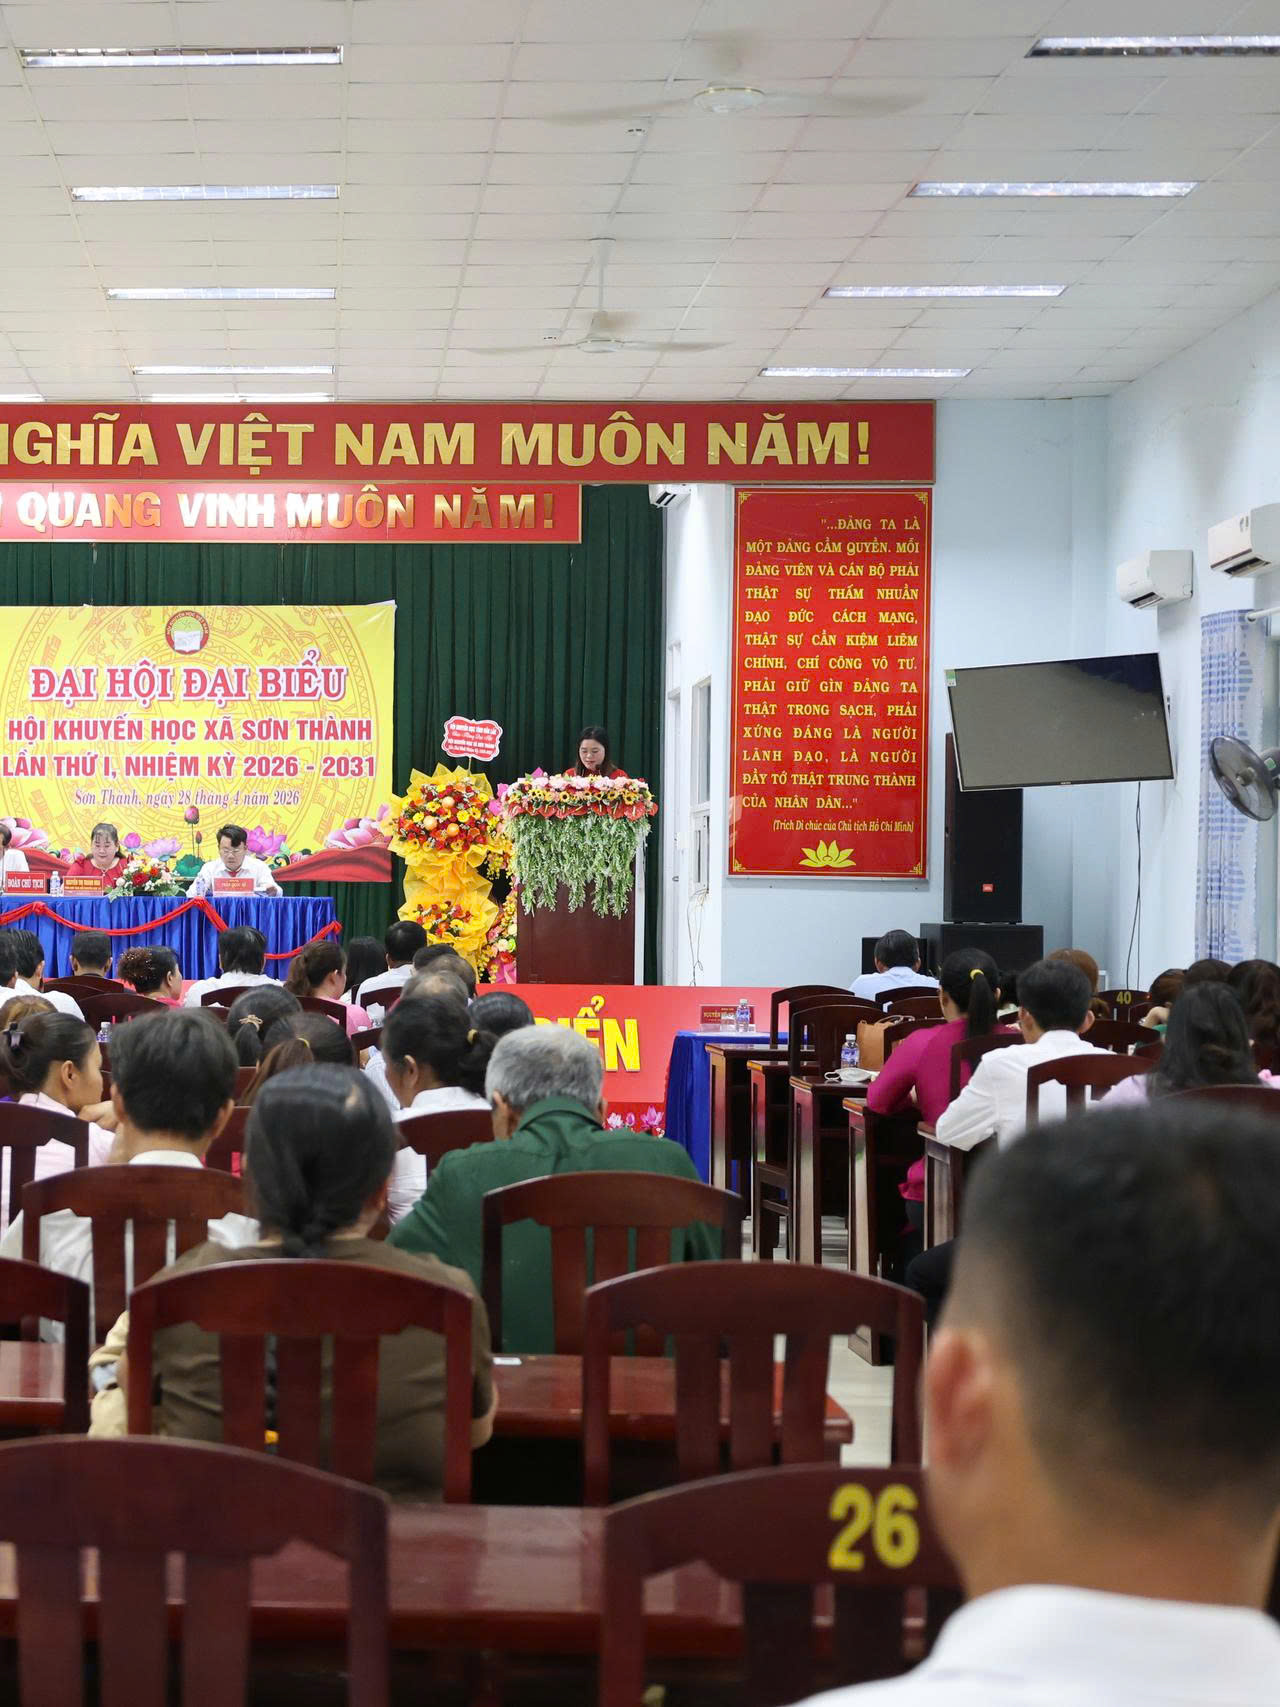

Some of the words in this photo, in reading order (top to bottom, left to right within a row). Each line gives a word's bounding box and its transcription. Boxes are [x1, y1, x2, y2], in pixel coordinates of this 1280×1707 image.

[175, 413, 314, 475] VIỆT
[335, 422, 475, 466] NAM
[501, 410, 686, 466] MUÔN
[706, 413, 870, 466] NĂM!
[17, 491, 161, 533] QUANG
[178, 492, 275, 529] VINH
[286, 484, 415, 529] MUÔN
[434, 487, 554, 529] NĂM!
[881, 520, 896, 529] TA
[905, 517, 920, 529] LÀ
[746, 539, 772, 556] MỘT
[777, 538, 810, 552] ĐẢNG
[815, 537, 841, 552] CẦM
[746, 562, 779, 576] ĐẢNG
[785, 563, 813, 576] VIÊN
[819, 563, 834, 576] VÀ
[840, 562, 864, 576] CÁN
[869, 563, 885, 579] BỘ
[890, 562, 919, 576] PHẢI
[746, 586, 778, 602] THẬT
[796, 588, 811, 603] SỰ
[829, 584, 864, 599] THẤM
[877, 584, 918, 599] NHUẦN
[745, 612, 770, 625] ĐẠO
[789, 609, 814, 622] ĐỨC
[833, 609, 866, 622] CÁCH
[745, 632, 777, 648] THẬT
[787, 633, 803, 649] SỰ
[812, 630, 836, 646] CẦN
[846, 633, 877, 649] KIỆM
[888, 633, 918, 646] LIÊM
[745, 656, 787, 670] CHÍNH,
[797, 655, 819, 669] CHÍ
[829, 656, 862, 669] CÔNG
[872, 656, 888, 669] VÔ
[898, 657, 917, 669] TƯ.
[31, 668, 96, 705] ĐẠI
[107, 659, 171, 705] HỘI
[183, 669, 246, 705] ĐẠI
[259, 649, 345, 697] BIỂU
[744, 678, 775, 693] PHẢI
[787, 678, 810, 693] GIỮ
[820, 678, 843, 693] GÌN
[853, 678, 890, 693] ĐẢNG
[900, 682, 917, 693] TA
[744, 702, 777, 718] THẬT
[787, 704, 829, 716] TRONG
[840, 705, 876, 718] SẠCH,
[888, 701, 917, 716] PHẢI
[8, 716, 45, 745] HỘI
[54, 714, 143, 740] KHUYẾN
[151, 720, 196, 745] HỌC
[204, 717, 233, 740] XÃ
[242, 718, 289, 740] SƠN
[297, 716, 371, 740] THÀNH
[743, 724, 782, 739] XỨNG
[793, 724, 832, 739] ĐÁNG
[844, 725, 862, 739] LÀ
[872, 725, 917, 739] NGƯỜI
[3, 749, 45, 777] LẦN
[54, 752, 98, 777] THỨ
[104, 756, 117, 778] I,
[126, 752, 198, 781] NHIỆM
[208, 753, 235, 777] KỲ
[244, 757, 299, 777] 2026
[322, 757, 375, 777] 2031
[794, 752, 829, 765] ĐẠO,
[841, 748, 858, 762] LÀ
[870, 748, 917, 763] NGƯỜI
[772, 772, 787, 784] TỚ
[792, 772, 824, 788] THẬT
[829, 775, 869, 785] TRUNG
[874, 772, 916, 786] THÀNH
[75, 789, 96, 805] Sơn
[102, 789, 141, 805] Thành,
[146, 791, 174, 808] ngày
[178, 790, 191, 805] 28
[195, 790, 229, 808] tháng
[233, 791, 239, 804] 4
[244, 791, 269, 805] năm
[274, 790, 300, 805] 2026
[742, 793, 767, 808] CỦA
[775, 795, 808, 808] NHÂN
[8, 877, 20, 888] ĐOÀN
[22, 876, 31, 888] CHỦ
[33, 878, 43, 889] TỊCH
[1116, 992, 1131, 1004] 40
[828, 1483, 919, 1571] 26
